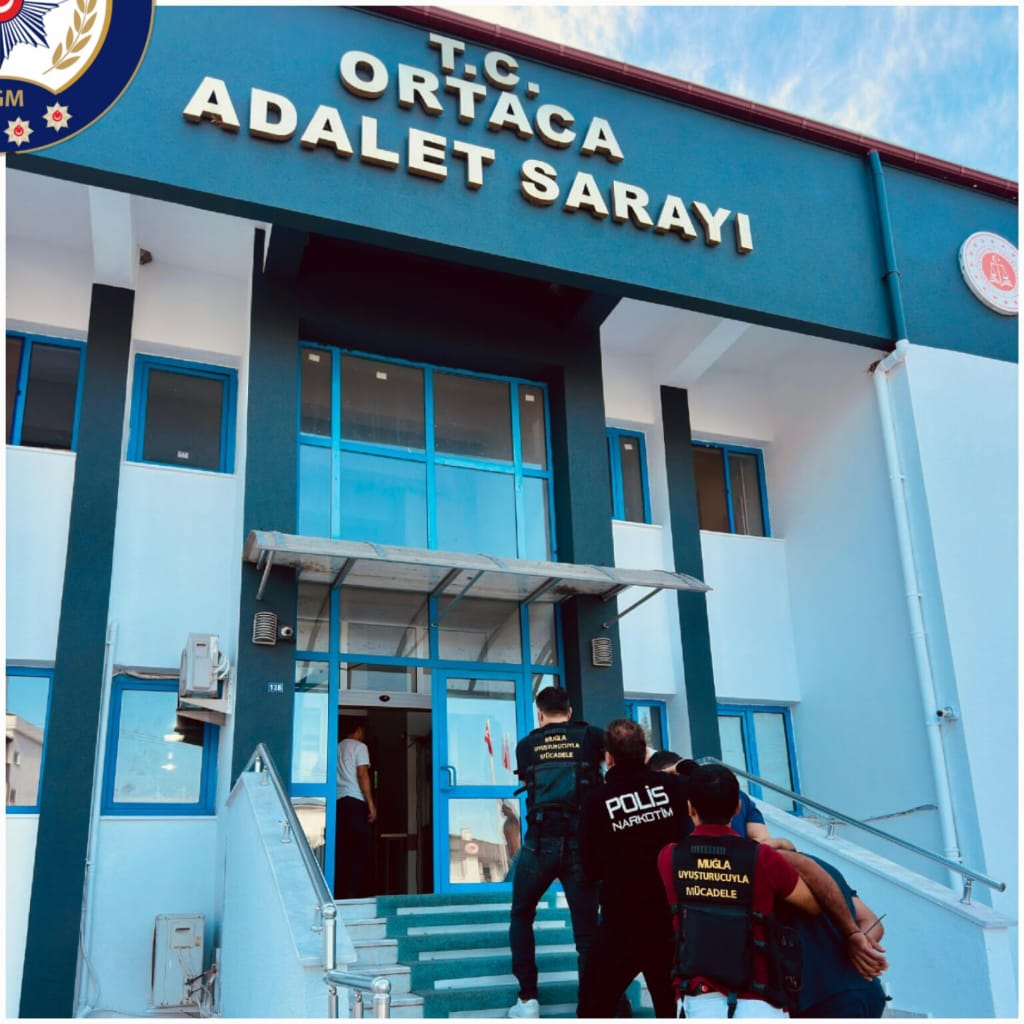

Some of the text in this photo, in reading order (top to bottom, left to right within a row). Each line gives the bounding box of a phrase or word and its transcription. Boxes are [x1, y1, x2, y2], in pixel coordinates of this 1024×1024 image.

[428, 33, 540, 98] T.C.
[339, 49, 625, 163] ORTACA
[183, 76, 753, 254] ADALET SARAYI
[678, 870, 750, 884] UYUŞTURUCUYLA
[697, 858, 731, 871] MUĞLA
[686, 886, 737, 899] MÜCADELE
